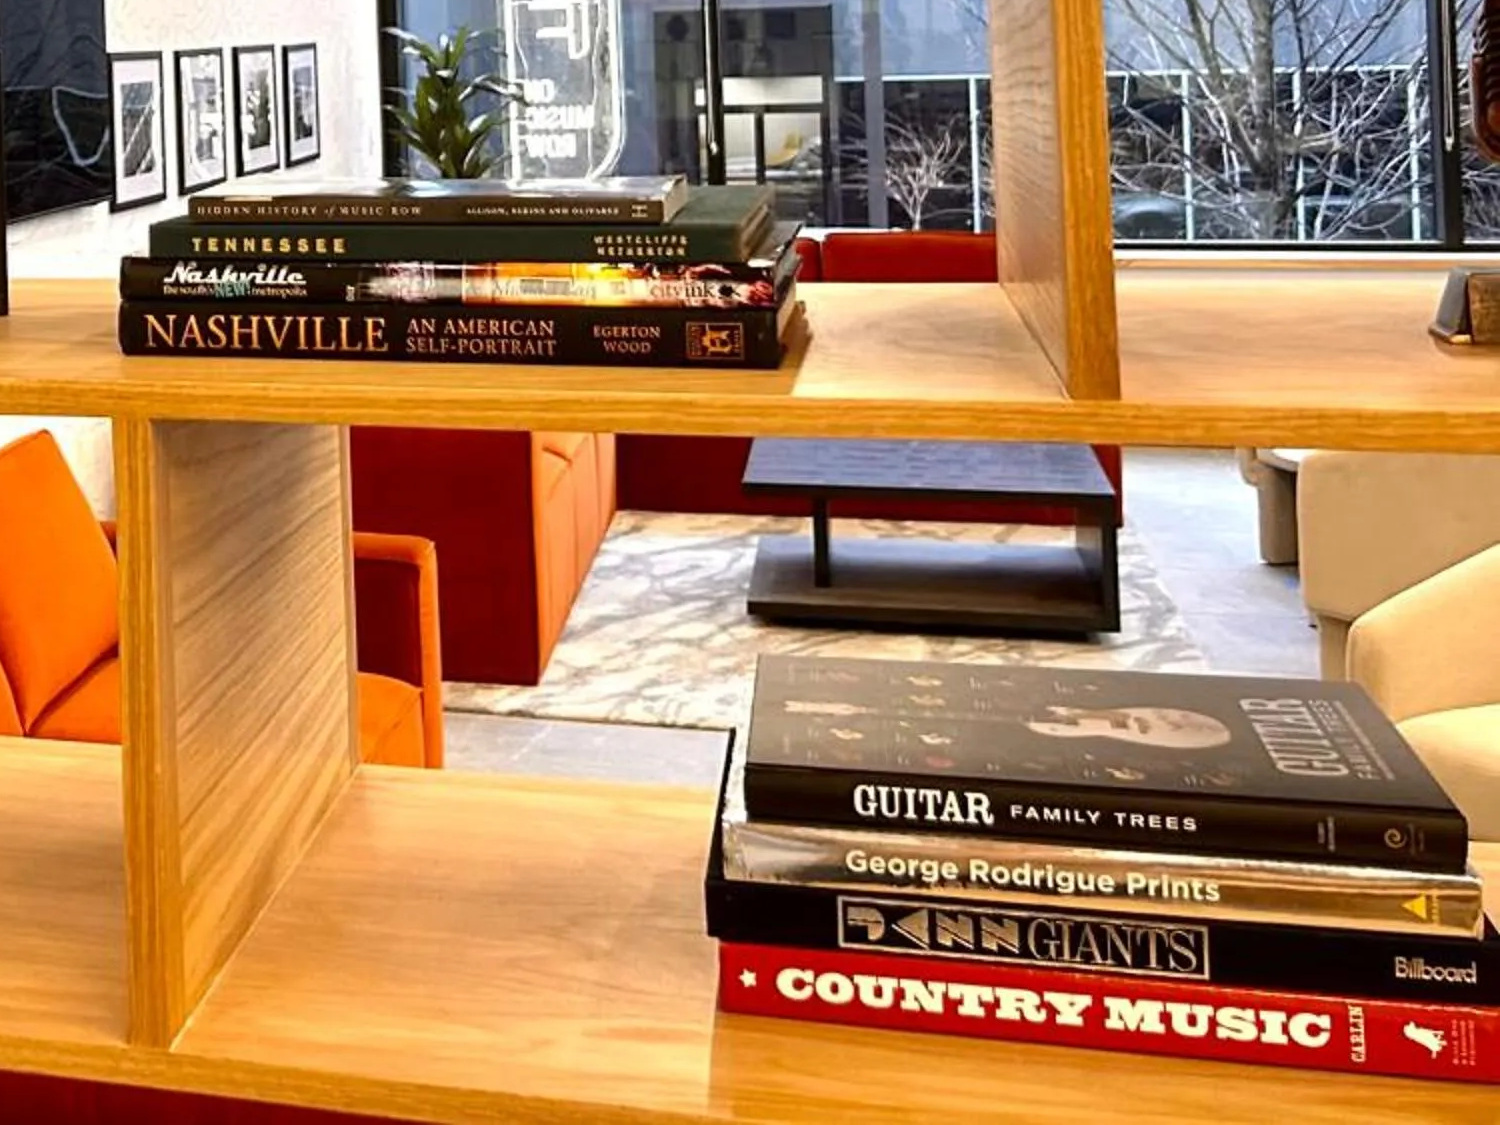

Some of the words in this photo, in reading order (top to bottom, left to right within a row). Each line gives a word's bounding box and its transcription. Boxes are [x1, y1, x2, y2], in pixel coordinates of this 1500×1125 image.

[197, 206, 250, 215] HIDDEN
[257, 206, 317, 215] HISTORY
[340, 206, 383, 215] MUSIC
[391, 206, 421, 215] ROW
[192, 237, 348, 254] TENNESSEE
[163, 260, 308, 285] Nashville
[143, 313, 390, 352] NASHVILLE
[406, 318, 436, 334] AN
[443, 318, 555, 337] AMERICAN
[593, 325, 661, 339] EGERTON
[405, 337, 558, 357] SELF-PORTRAIT
[603, 340, 652, 354] WOOD
[853, 784, 995, 825] GUITAR
[1010, 805, 1101, 825] FAMILY
[1114, 812, 1198, 831] TREES
[845, 849, 960, 882] George
[968, 858, 1116, 896] Rodrigue
[1127, 869, 1221, 903] Prints
[1026, 918, 1198, 973] GIANTS
[1394, 956, 1477, 984] Billboard
[775, 968, 1093, 1026] COUNTRY
[1104, 996, 1332, 1048] MUSIC
